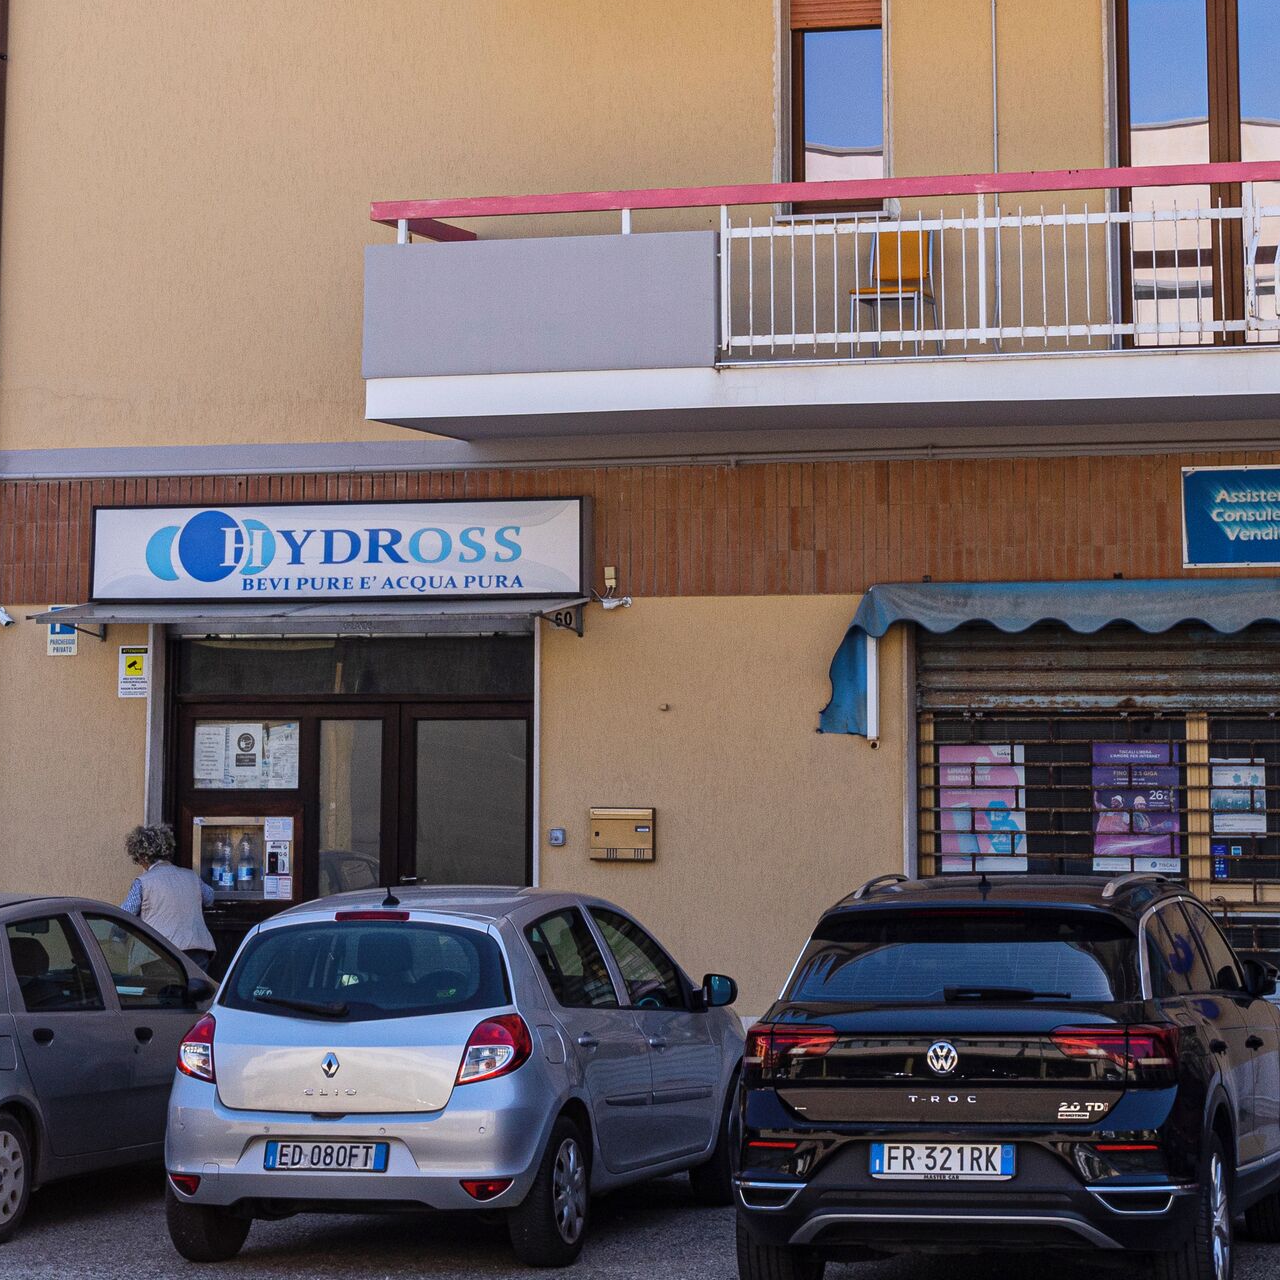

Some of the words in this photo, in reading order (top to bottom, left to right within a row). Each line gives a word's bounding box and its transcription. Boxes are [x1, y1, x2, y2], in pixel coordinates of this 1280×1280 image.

[219, 525, 523, 569] HYDROSS
[241, 577, 291, 591] BEVI
[296, 576, 354, 590] PURE
[381, 575, 460, 592] ACQUA
[464, 574, 524, 589] PURA
[52, 646, 72, 654] PRIVATO
[1149, 790, 1163, 800] 26
[304, 1088, 357, 1096] CLIO
[909, 1095, 977, 1103] T-ROC
[279, 1144, 302, 1166] ED
[310, 1145, 373, 1167] 080FT
[887, 1146, 915, 1170] FR
[924, 1146, 998, 1172] 321RK
